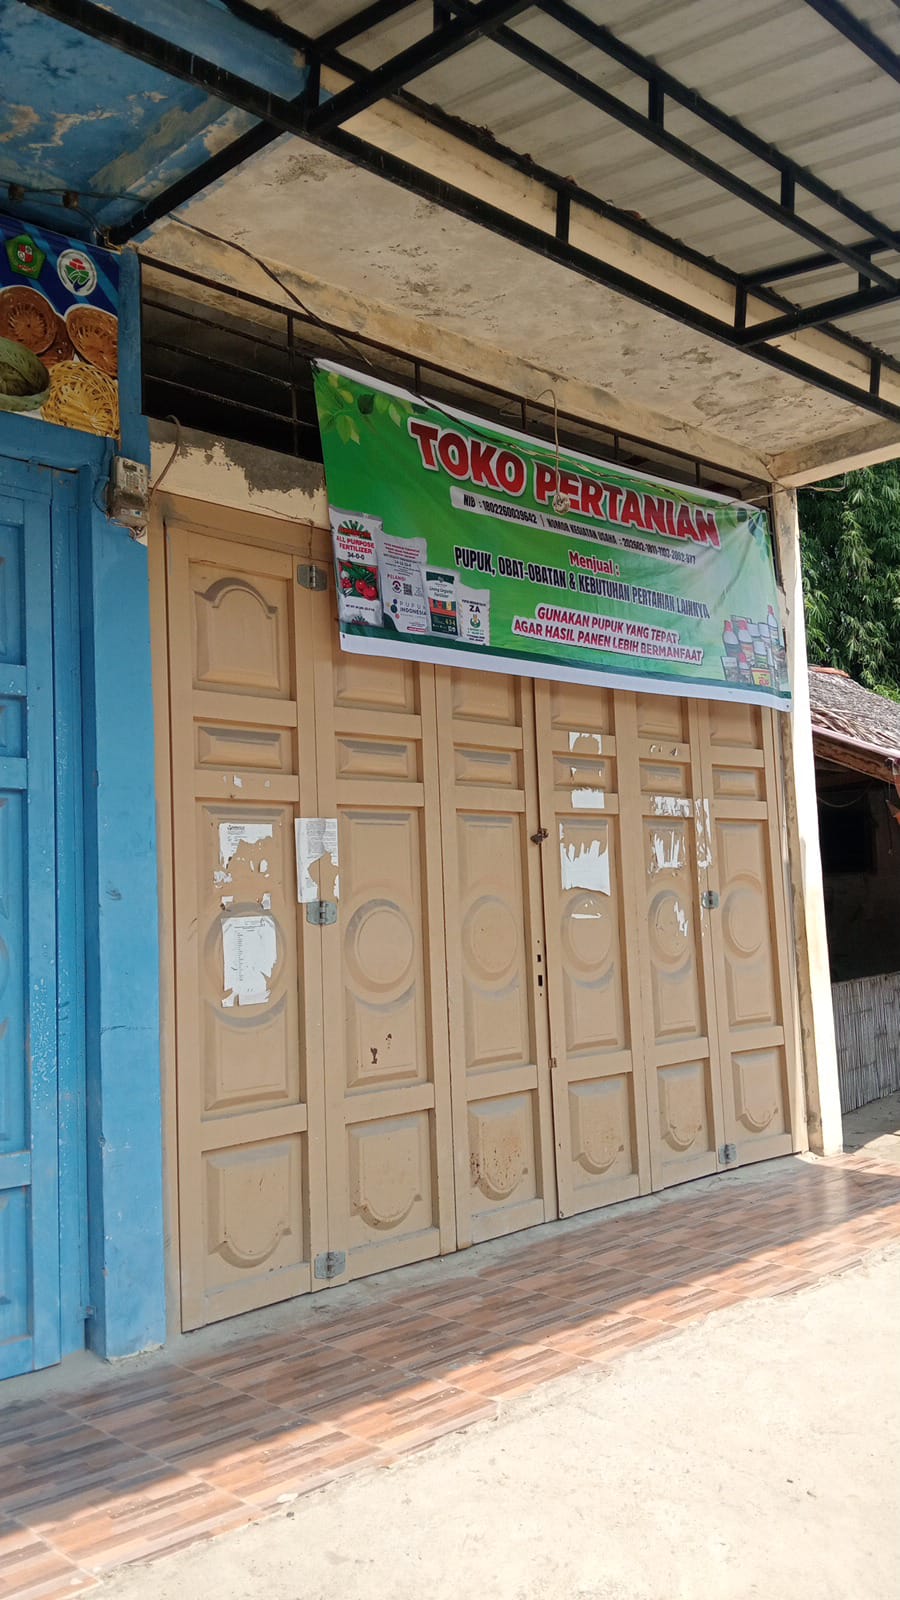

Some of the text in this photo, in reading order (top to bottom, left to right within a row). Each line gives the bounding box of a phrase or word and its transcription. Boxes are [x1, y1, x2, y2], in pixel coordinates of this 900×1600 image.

[408, 419, 721, 548] TOKO PERTANIAN
[463, 494, 476, 507] NIB
[339, 543, 373, 555] FERTILIZER
[347, 537, 376, 549] PURPOSE
[568, 551, 613, 575] Menjual
[454, 546, 495, 576] PUPUK,
[498, 556, 567, 589] OBAT-OBATAN
[569, 572, 577, 590] &
[578, 573, 631, 602] KEBUTUHAN
[632, 585, 675, 612] PERTANIAN
[676, 597, 711, 620] LAINNYA
[514, 619, 702, 661] AGAR HASIL PANEN LEBIH BERMANFAAT
[537, 606, 677, 644] GUNAKAN PUPUK YANG TEPAT
